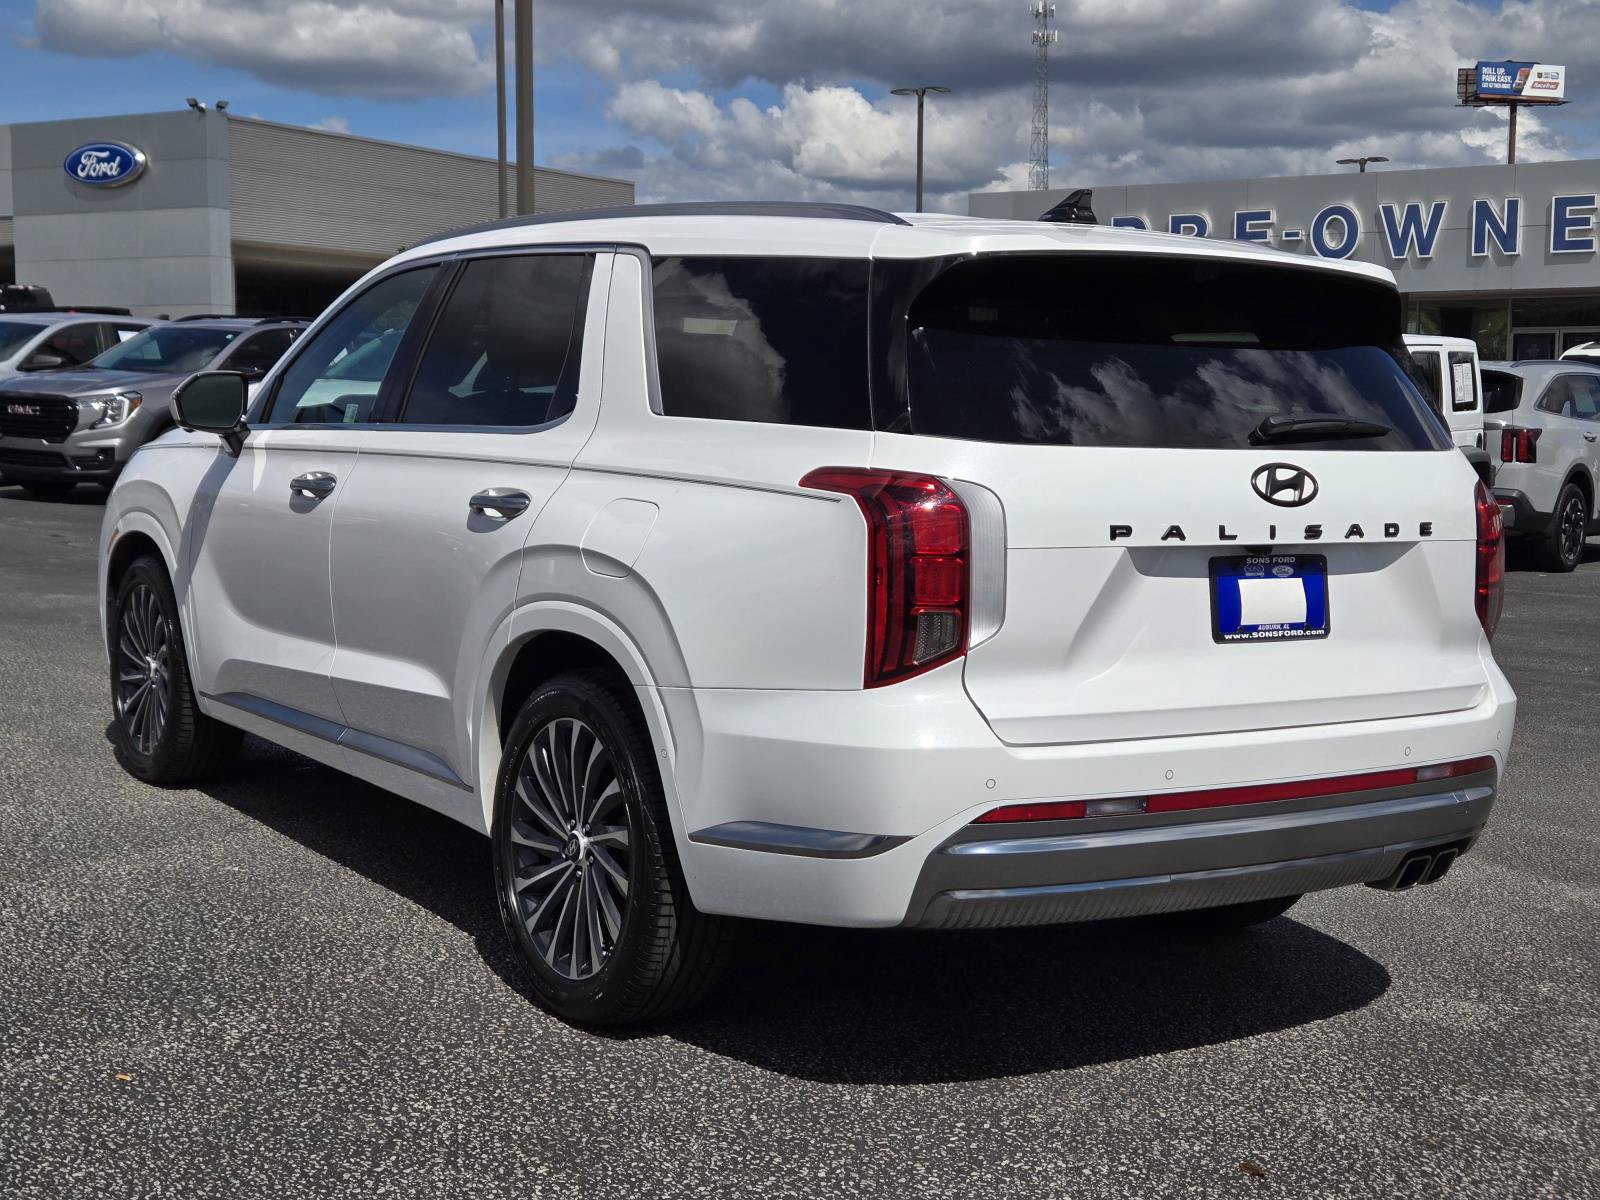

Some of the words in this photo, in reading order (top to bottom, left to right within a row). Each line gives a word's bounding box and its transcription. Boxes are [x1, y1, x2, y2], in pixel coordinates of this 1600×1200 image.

[1482, 67, 1496, 75] ROLL
[1481, 74, 1497, 82] PARK
[77, 150, 121, 178] Ford
[1111, 193, 1598, 259] E-OWNE
[8, 404, 40, 415] GMC
[1109, 521, 1433, 541] PALISADE
[1272, 556, 1296, 564] FORD
[1224, 629, 1325, 640] www.SONSFORD.com
